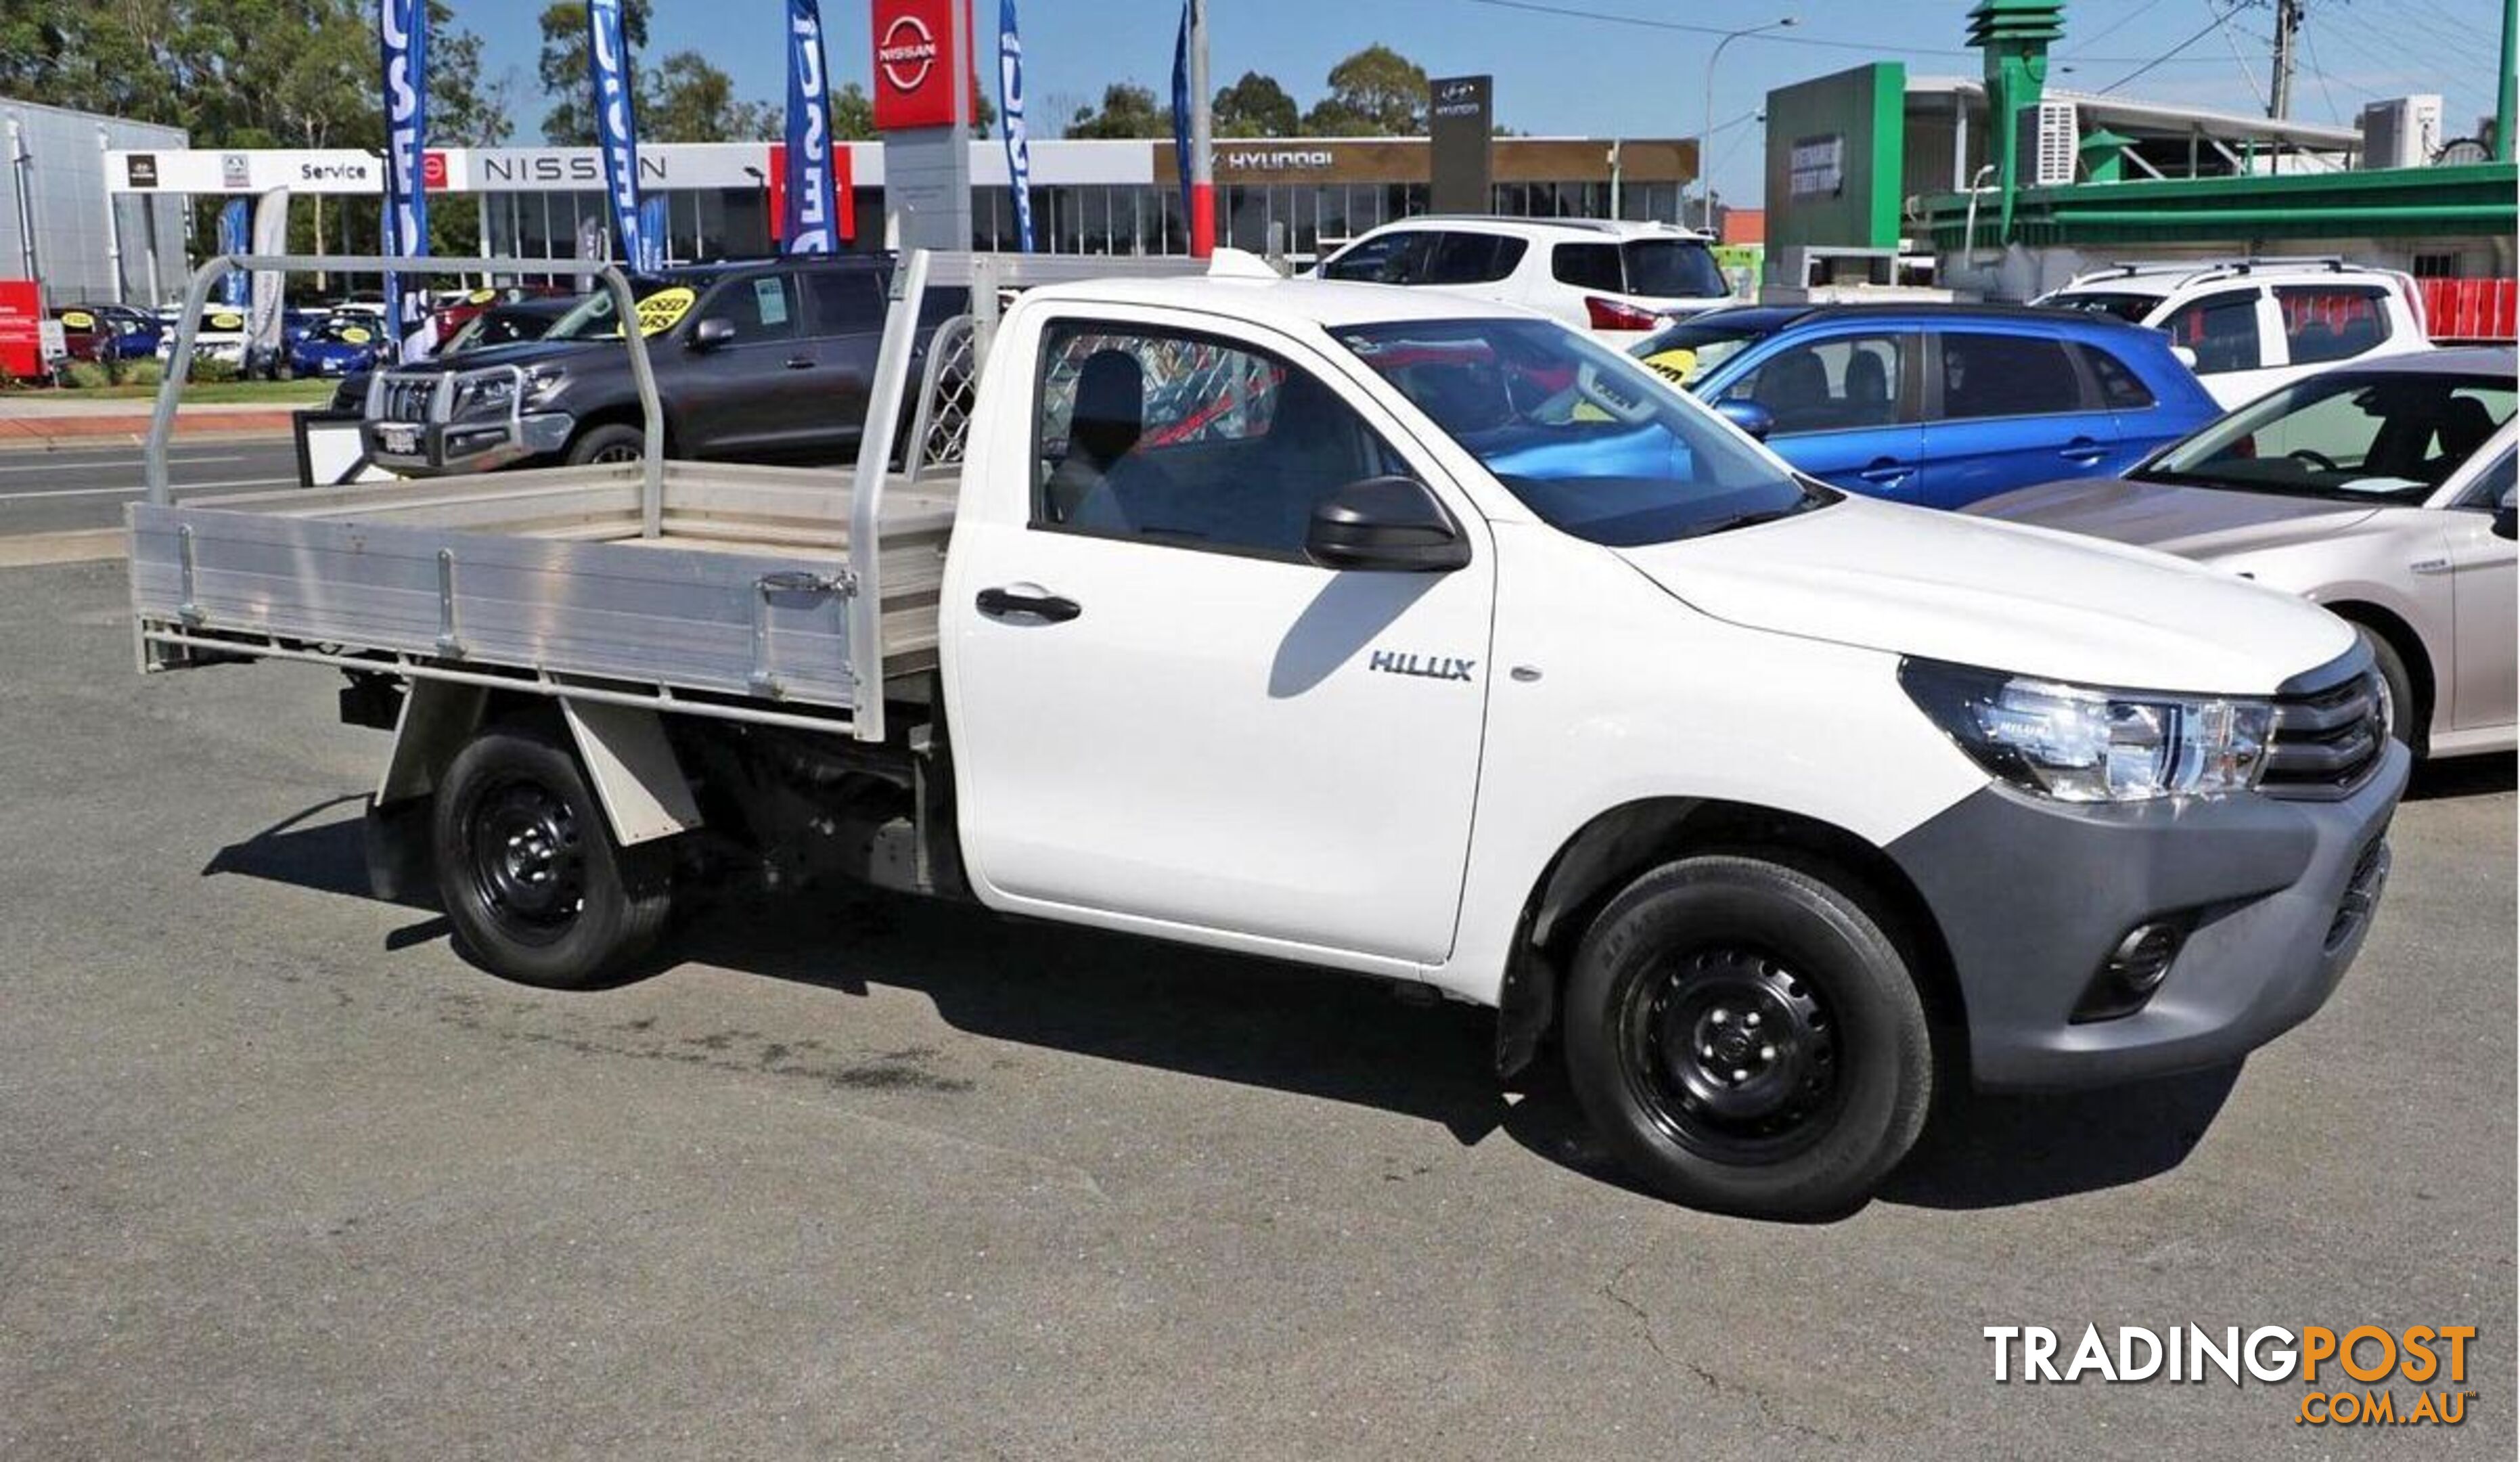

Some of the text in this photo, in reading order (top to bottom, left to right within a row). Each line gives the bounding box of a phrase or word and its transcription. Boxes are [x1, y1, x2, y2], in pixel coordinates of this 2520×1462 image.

[879, 43, 935, 61] NISSAN
[302, 162, 366, 180] Service
[484, 157, 667, 181] NISSN
[639, 314, 676, 329] ARS
[1369, 650, 1477, 682] HILUX
